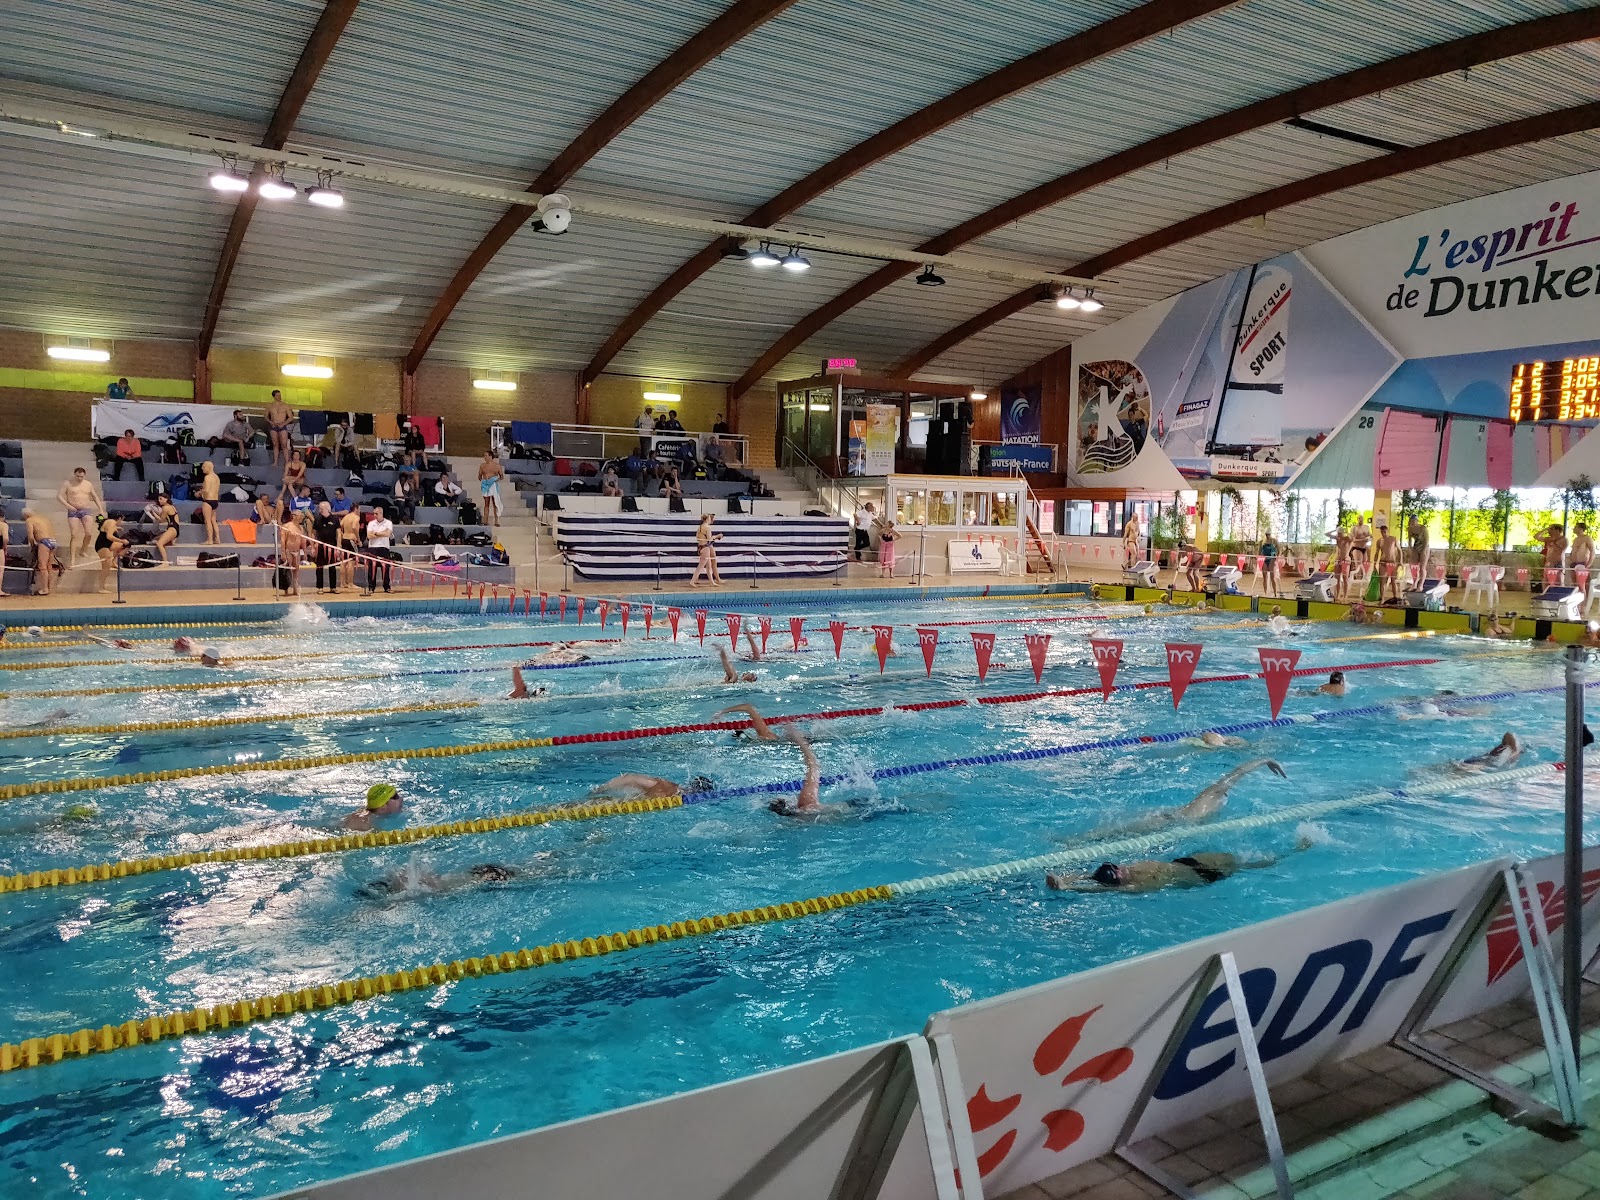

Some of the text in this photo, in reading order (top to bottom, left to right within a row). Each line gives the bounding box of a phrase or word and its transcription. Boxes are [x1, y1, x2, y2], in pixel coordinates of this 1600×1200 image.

[1404, 202, 1579, 279] L'esprit
[1386, 259, 1600, 318] de Dunke
[1238, 282, 1286, 347] Dunkerque
[1250, 331, 1286, 376] SPORT
[1518, 357, 1600, 377] 1 2 3:03
[1511, 379, 1523, 392] 2
[1531, 377, 1542, 391] 5
[1183, 401, 1208, 411] FINAGAZ
[1511, 394, 1522, 407] 3
[1530, 392, 1541, 406] 3
[1510, 409, 1521, 421] 4
[1534, 408, 1540, 420] 1
[1358, 416, 1374, 428] 28
[1003, 435, 1039, 444] NATATION
[991, 458, 1049, 469] auts-de-France
[1218, 462, 1258, 471] Dunkerque
[875, 628, 889, 639] TYR
[920, 634, 935, 644] TYR
[974, 638, 991, 650] TYR
[1095, 646, 1118, 659] TYR
[1170, 650, 1194, 663] TYR
[1263, 658, 1291, 672] TYR
